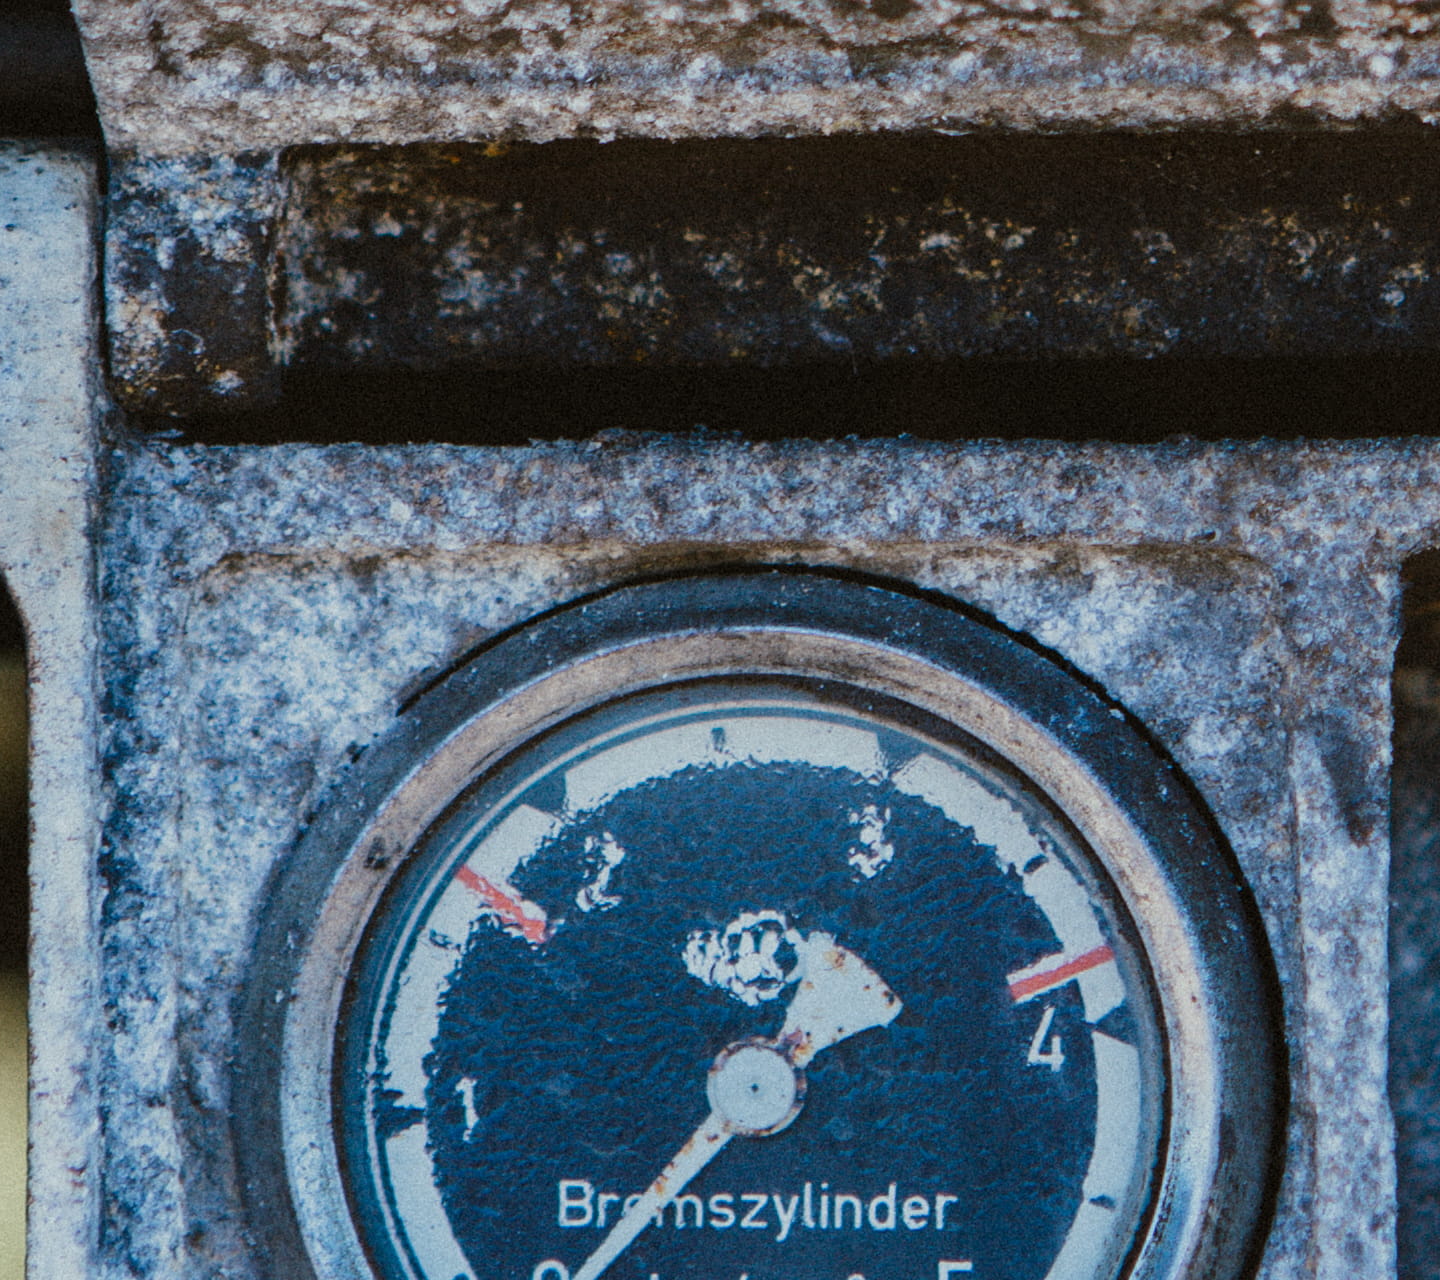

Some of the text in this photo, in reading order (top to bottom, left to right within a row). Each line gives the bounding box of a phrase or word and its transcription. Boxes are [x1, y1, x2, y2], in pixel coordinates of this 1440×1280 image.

[576, 832, 625, 912] 2
[849, 804, 895, 881] 3
[1026, 1004, 1066, 1072] 4
[454, 1077, 480, 1144] 1
